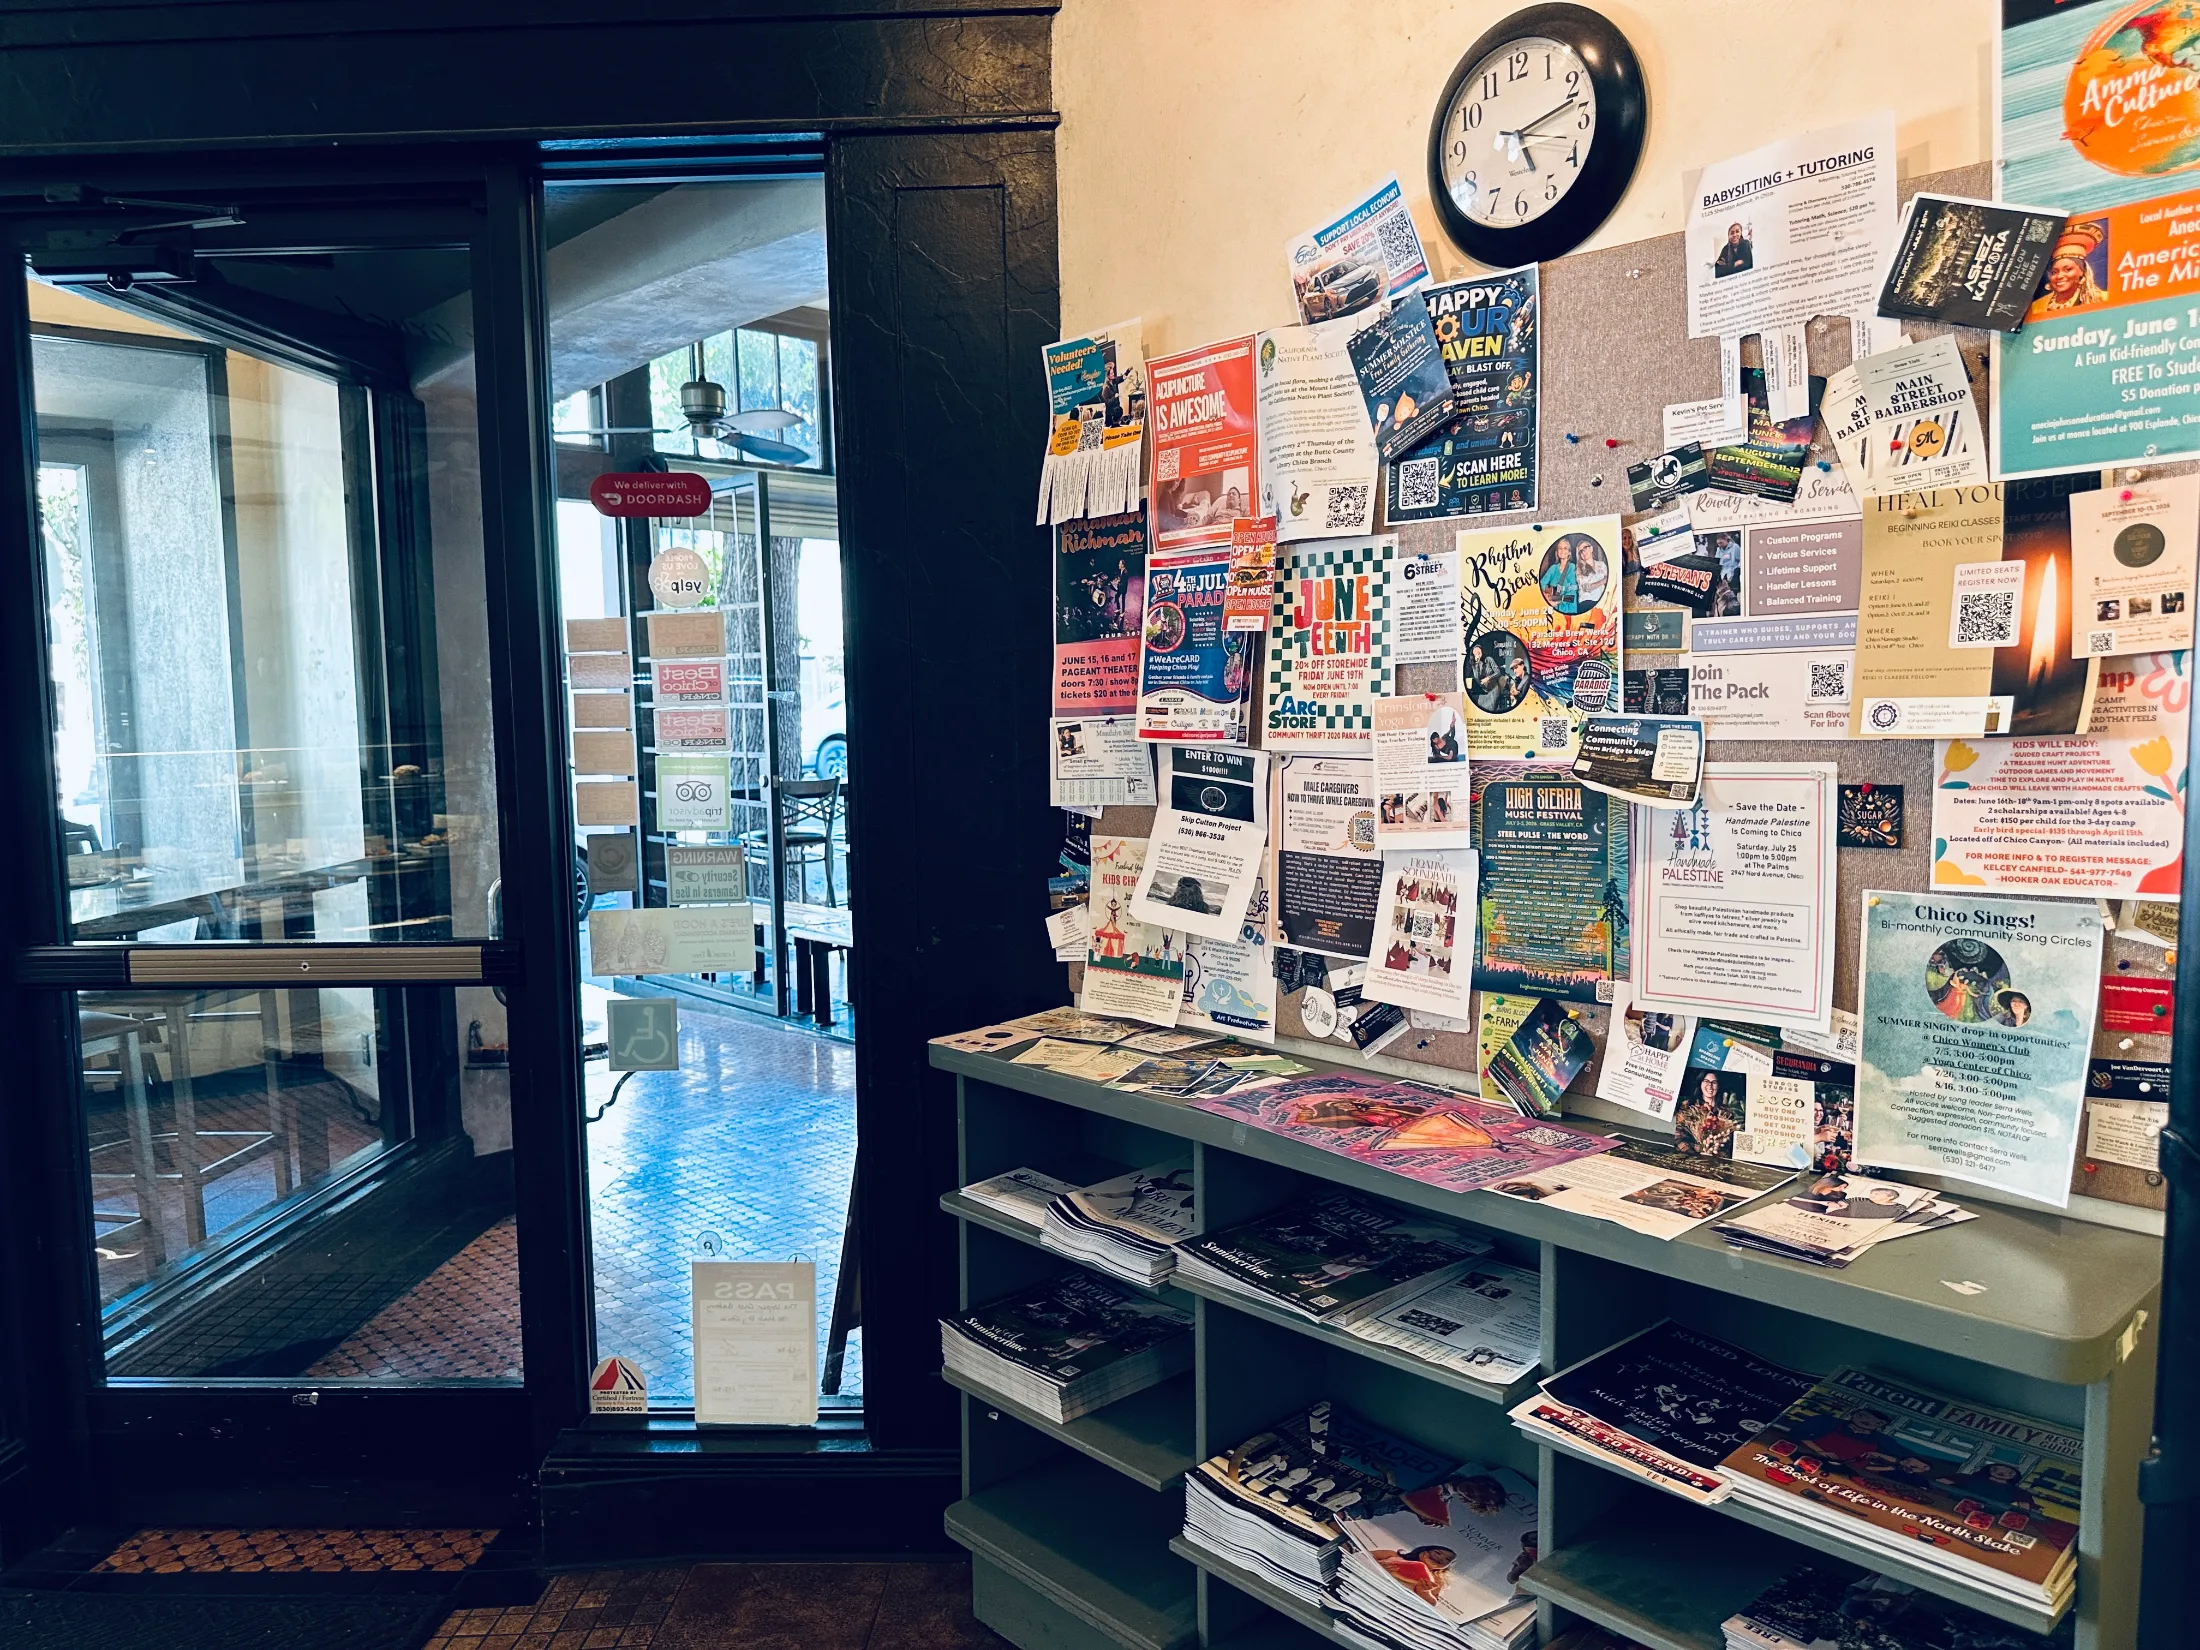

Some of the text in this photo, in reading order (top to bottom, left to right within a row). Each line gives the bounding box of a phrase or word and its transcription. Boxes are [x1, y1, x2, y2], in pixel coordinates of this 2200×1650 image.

[1508, 52, 1529, 83] 12
[1545, 54, 1553, 81] 1
[1483, 72, 1499, 101] 11
[1565, 71, 1579, 100] 2
[2080, 63, 2168, 115] Amma
[1461, 103, 1482, 133] 10
[1577, 101, 1590, 129] 3
[1454, 141, 1466, 166] 9
[1565, 140, 1578, 168] 4
[1465, 171, 1477, 196] 8
[1545, 174, 1557, 200] 5
[1703, 171, 1782, 208] BABYSITTING
[1797, 147, 1874, 177] TUTORING
[1489, 187, 1501, 214] 7
[1515, 189, 1528, 216] 6
[1319, 187, 1399, 247] SUPPORT LOCAL ECONOMY
[2140, 204, 2193, 224] Local Author
[2006, 249, 2026, 289] FOLLOW
[2020, 254, 2040, 290] RABBIT
[1426, 287, 1502, 317] HAPPY
[2033, 317, 2176, 354] Sunday, June
[1049, 345, 1097, 365] Volunteers
[1278, 346, 1317, 355] CALIFORNIA
[1278, 350, 1347, 364] NATIVE PLANT SOCIETY
[1360, 319, 1427, 378] SUMMER SOLSTICE
[2075, 339, 2177, 367] A Fun Kid-friendly
[1050, 358, 1084, 377] Needed!
[1467, 361, 1512, 374] BLAST OFF.
[2112, 364, 2163, 384] FREE To
[1156, 372, 1205, 400] ACUPUNCTURE
[1890, 382, 1944, 405] STREET
[1894, 374, 1934, 393] MAIN
[2121, 382, 2191, 402] $5 Donation
[1156, 406, 1168, 432] IS
[1170, 390, 1227, 429] AWESOME
[1672, 404, 1710, 417] Kevin's Pet
[1874, 388, 1966, 420] BARBERSHOP
[1715, 452, 1777, 470] SEPTEMBER
[1737, 446, 1776, 461] AUGUST
[1456, 453, 1521, 477] SCAN HERE
[614, 480, 687, 490] We deliver with
[1457, 468, 1528, 489] TO LEARN MORE!
[627, 494, 702, 505] DOORDASH
[1878, 492, 1944, 512] HEAL
[1888, 517, 2000, 533] BEGINNING REIKI CLASSES
[1061, 529, 1144, 554] Richman
[1766, 531, 1843, 545] Custom Programs
[1415, 563, 1443, 575] STREET
[1465, 539, 1534, 588] Rhythm
[1766, 562, 1837, 576] Lifetime Support
[1959, 565, 2020, 577] LIMITED SEATS
[1647, 562, 1712, 591] ESTEVAN'S
[1957, 578, 1994, 587] REGISTER
[1494, 567, 1540, 609] Brews
[1177, 590, 1225, 609] PARAD
[1294, 576, 1370, 630] JUNE
[1766, 593, 1841, 607] Balanced Training
[1294, 621, 1370, 659] TEENTH
[1149, 655, 1200, 664] #WeAreCARD
[1061, 664, 1137, 676] PAGEANT THEATER
[1298, 671, 1363, 681] FRIDAY JUNE 19TH
[1691, 664, 1723, 681] Join
[1061, 678, 1104, 688] doors 7:30
[1574, 679, 1610, 690] PARADISE
[1691, 682, 1769, 700] The Pack
[1061, 689, 1108, 699] tickets $20
[1280, 695, 1317, 716] ARC
[1268, 709, 1316, 729] STORE
[1589, 724, 1639, 735] Connecting
[1586, 735, 1639, 747] Community
[2012, 739, 2099, 749] KIDS WILL ENJOY:
[1185, 749, 1243, 766] ENTER TO WIN
[1303, 780, 1359, 794] MALE CAREGIVERS
[1505, 788, 1582, 810] HIGH SIERRA
[1505, 811, 1583, 820] MUSIC FESTIVAL
[1770, 818, 1811, 827] Palestine
[1857, 810, 1883, 820] SUGAR
[1102, 873, 1122, 885] KIDS
[1662, 868, 1724, 883] PALESTINE
[1983, 864, 2017, 872] KELCEY
[2019, 865, 2068, 874] CANFIELD-
[1915, 904, 2035, 929] Chico Sings!
[1881, 919, 2092, 948] Bi-monthly Community Song Circles
[1495, 1016, 1519, 1028] FARM
[1877, 1016, 1921, 1029] SUMMER
[1644, 1047, 1671, 1062] HAPPY
[1961, 1037, 2006, 1052] Women's
[964, 1316, 1028, 1352] Summertime
[1672, 1330, 1738, 1361] NAKED
[1836, 1370, 1942, 1415] Parent
[1946, 1407, 2044, 1444] FAMILY
[1558, 1415, 1694, 1479] FREE TO ATTEND!
[1752, 1453, 2022, 1556] The Best of Life in the North State
